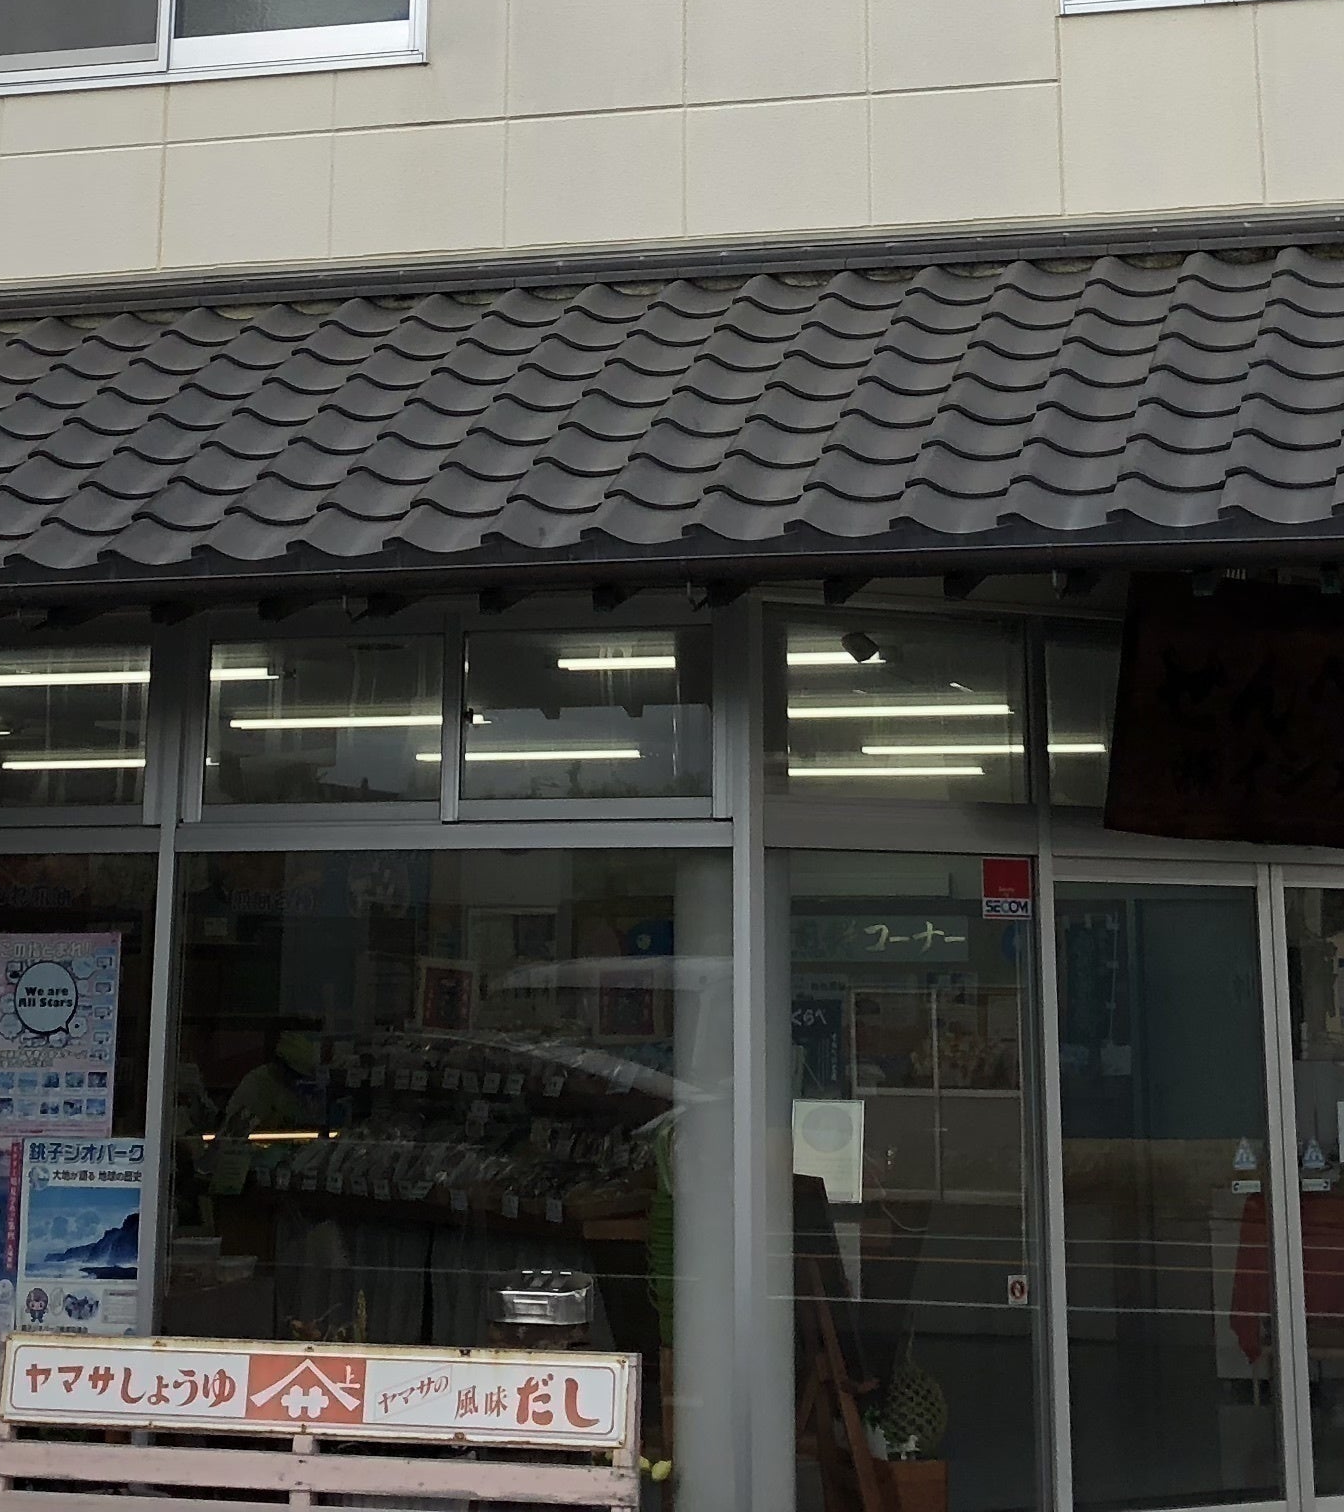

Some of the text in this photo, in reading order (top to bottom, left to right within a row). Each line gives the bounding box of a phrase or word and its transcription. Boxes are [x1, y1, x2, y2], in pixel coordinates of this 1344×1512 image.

[985, 899, 1029, 914] SECOM
[24, 986, 69, 996] We are
[18, 998, 73, 1007] All Stars
[29, 1142, 145, 1164] 銚子ジオパーク
[24, 1362, 237, 1408] ヤマサしょうゆ
[377, 1374, 450, 1414] ヤマサの
